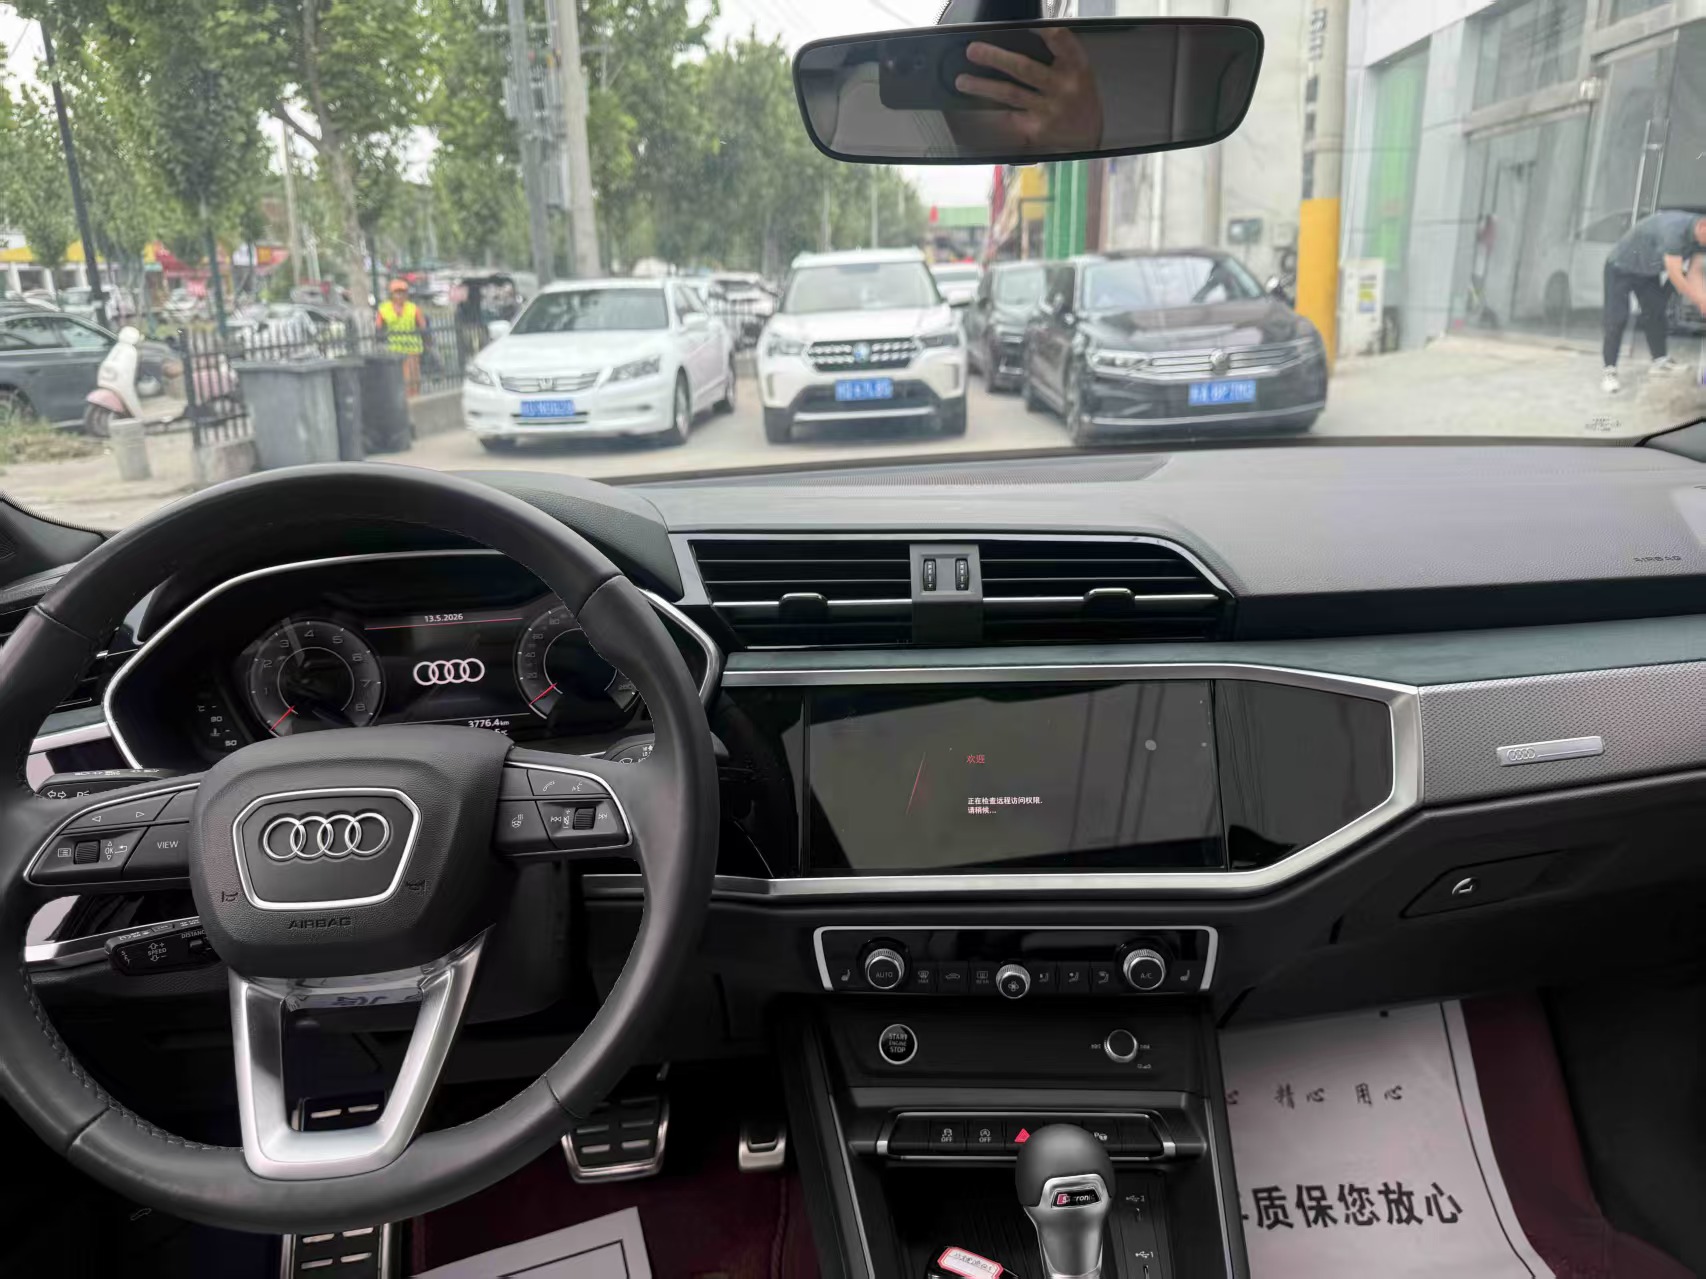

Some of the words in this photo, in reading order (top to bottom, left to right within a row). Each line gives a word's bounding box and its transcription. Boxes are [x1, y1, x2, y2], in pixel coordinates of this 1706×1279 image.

[424, 613, 464, 623] 13.5.2026
[304, 629, 314, 638] 4
[280, 639, 290, 648] 3
[332, 635, 343, 644] 5
[352, 653, 363, 662] 6
[263, 660, 272, 668] 2
[356, 703, 366, 712] 8
[967, 754, 985, 764] 欢迎
[157, 841, 179, 849] VIEW
[105, 847, 114, 855] OK
[288, 918, 352, 929] AIRBAG
[148, 948, 167, 956] SPEED
[888, 1033, 908, 1041] START
[1242, 1182, 1463, 1230] 质保您放心
